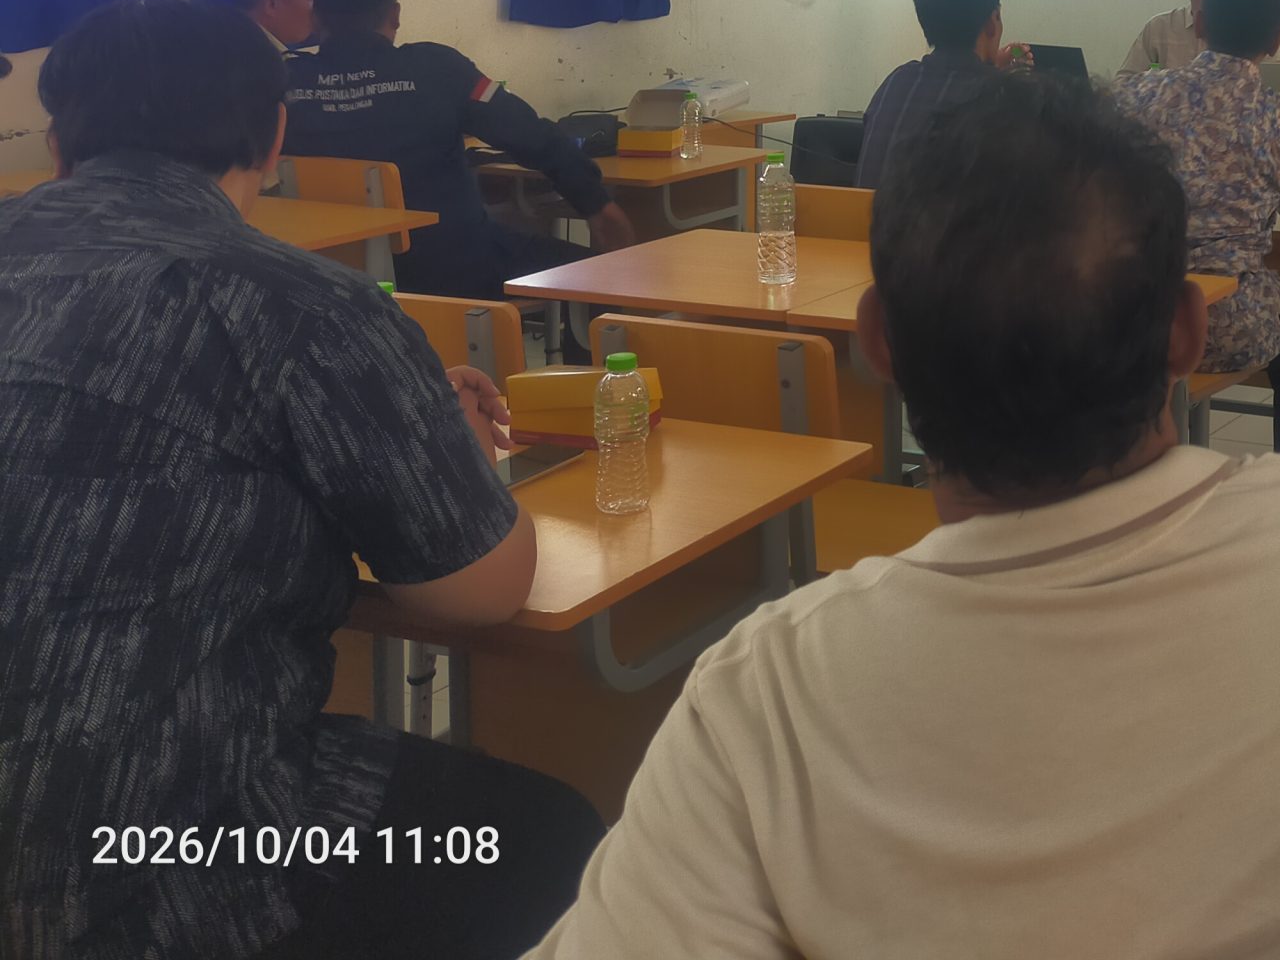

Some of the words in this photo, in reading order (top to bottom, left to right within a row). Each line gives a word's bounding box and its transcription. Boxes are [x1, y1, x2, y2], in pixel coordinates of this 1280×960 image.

[318, 74, 344, 86] MPI
[347, 70, 376, 81] NEWS
[366, 80, 416, 96] INFORMATIKA
